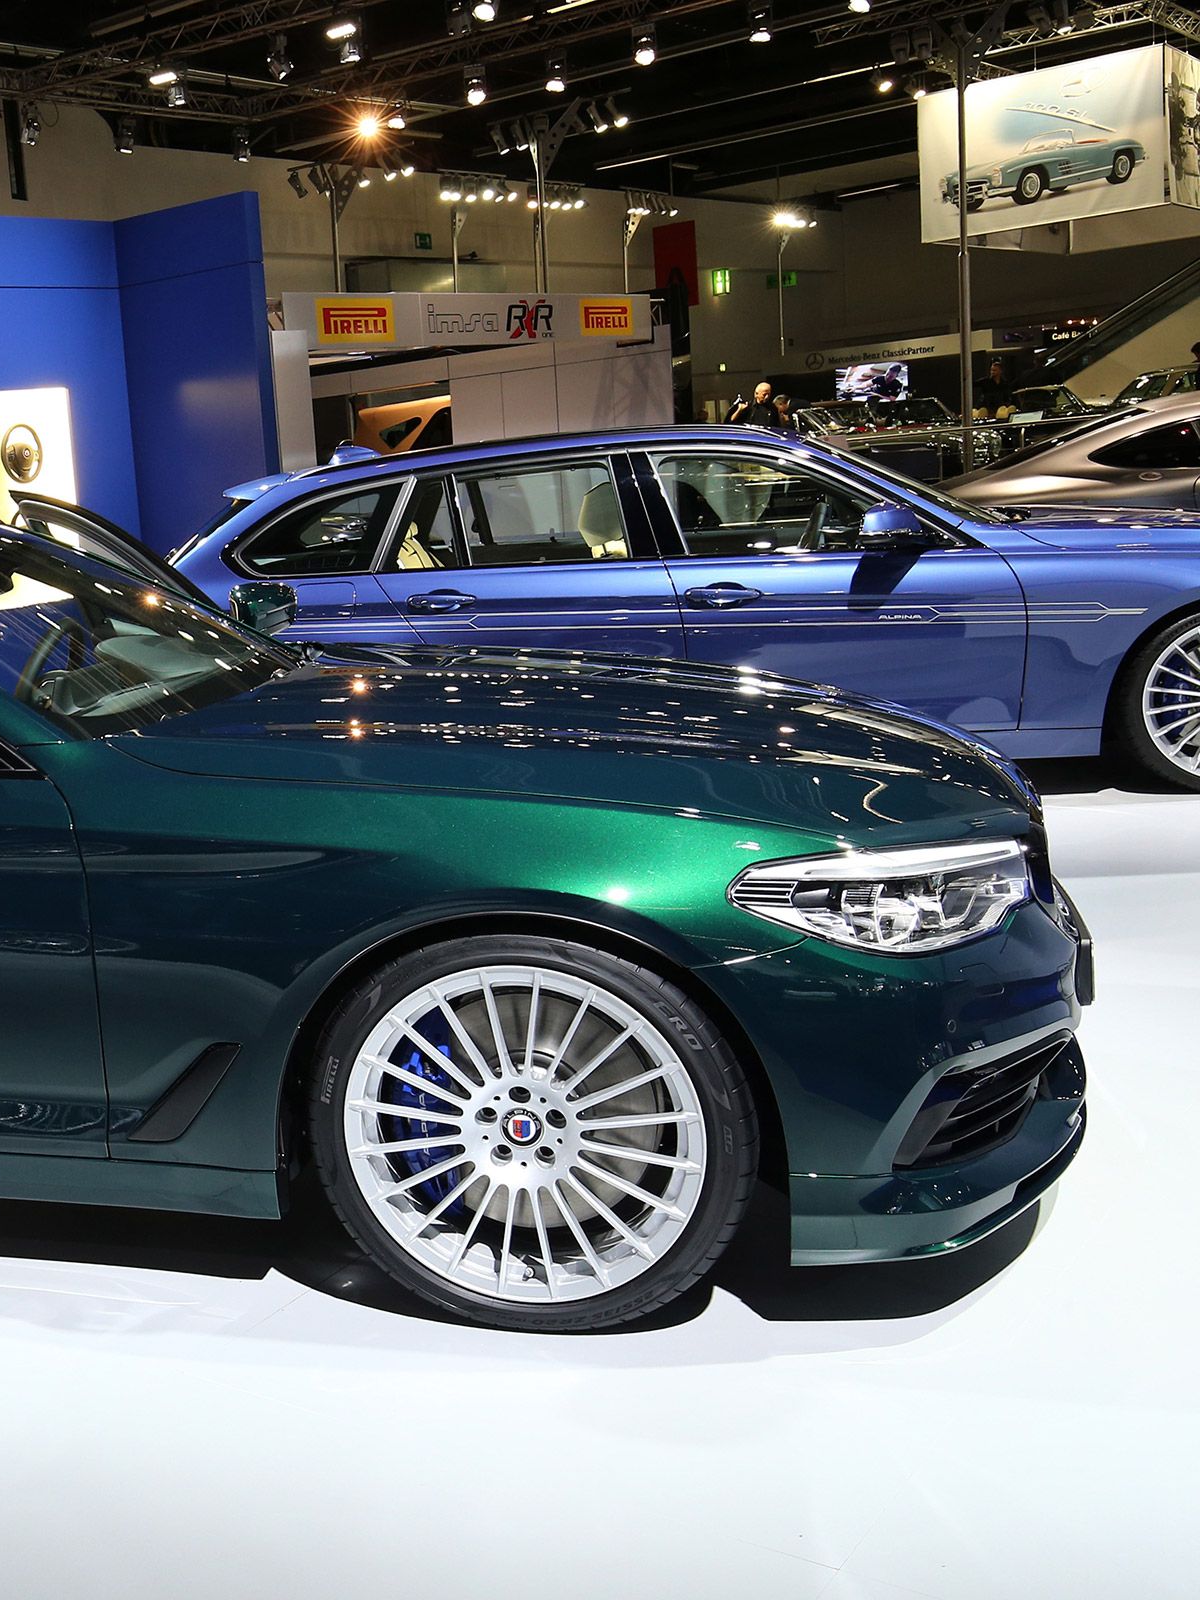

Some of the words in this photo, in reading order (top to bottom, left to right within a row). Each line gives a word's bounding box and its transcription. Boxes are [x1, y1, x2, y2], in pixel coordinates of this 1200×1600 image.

[322, 307, 388, 334] PIRELLI
[428, 304, 499, 333] imsa
[583, 306, 629, 329] PIRELLI
[828, 351, 880, 365] Mercedes-Benz
[882, 345, 935, 359] ClassicPartner
[320, 1056, 340, 1104] PIRELLI
[503, 1110, 541, 1130] ALPINA
